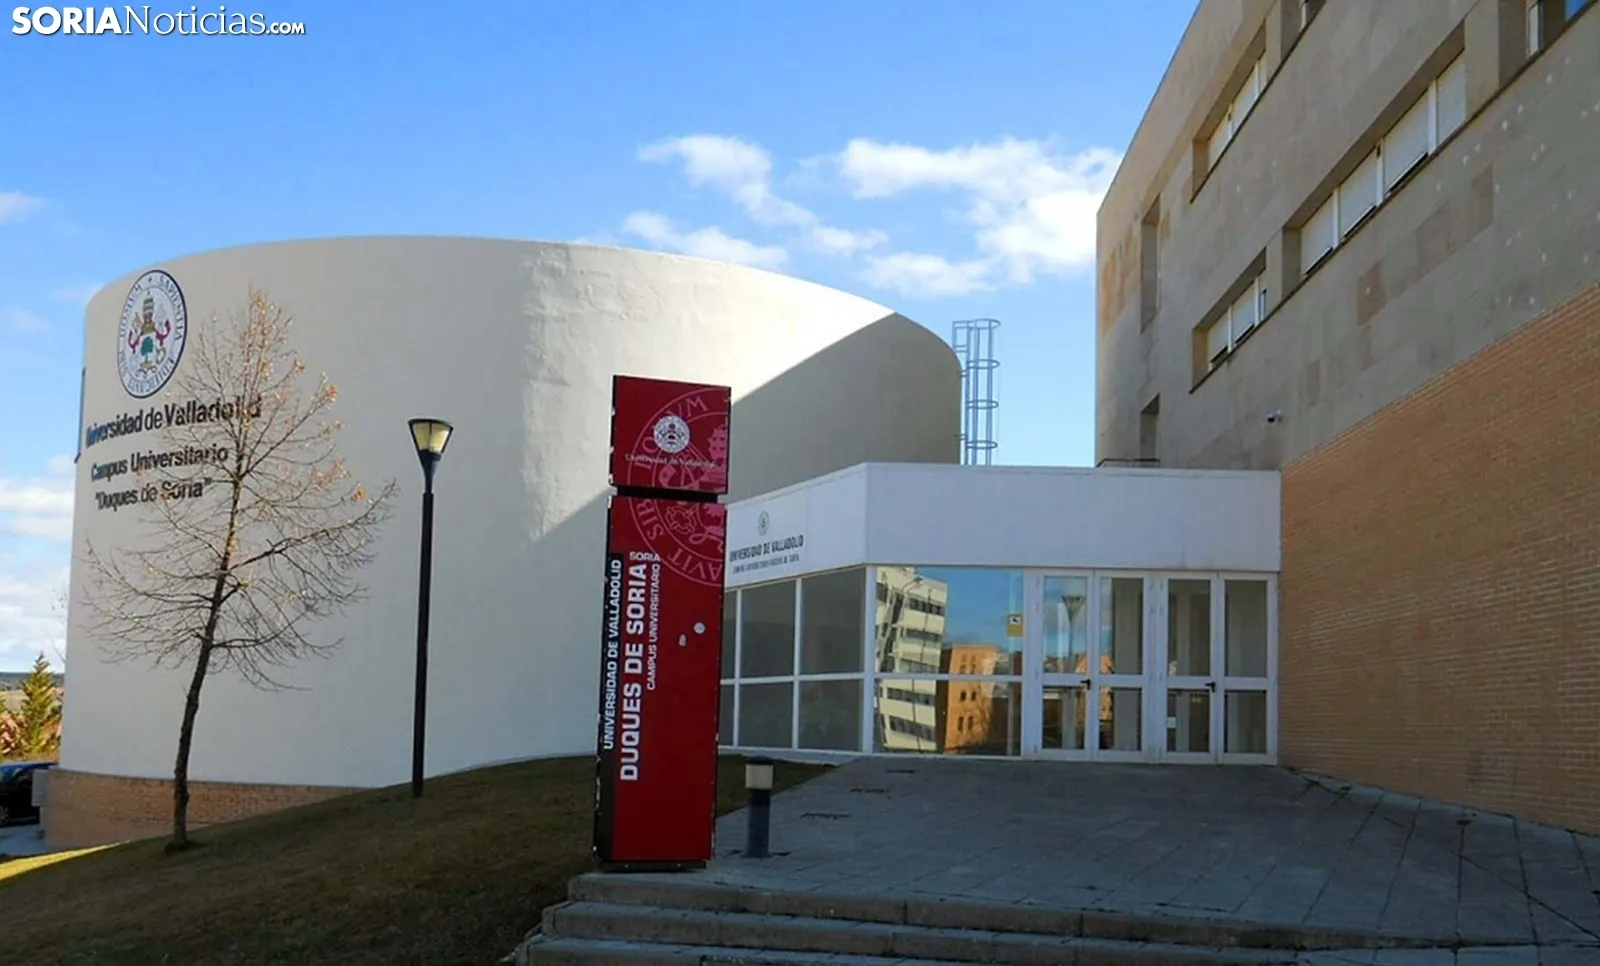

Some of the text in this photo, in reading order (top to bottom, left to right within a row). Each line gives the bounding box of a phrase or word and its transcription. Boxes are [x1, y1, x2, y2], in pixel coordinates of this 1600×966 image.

[145, 407, 163, 431] de
[91, 443, 229, 482] Campus Universitario
[141, 483, 158, 502] de
[629, 551, 661, 562] SORIA
[646, 563, 661, 691] CAMPUS UNIVERSITARIO
[604, 559, 622, 749] UNIVERSIDAD DE VALLADOLID
[620, 564, 647, 781] DUQUES DE SORIA
